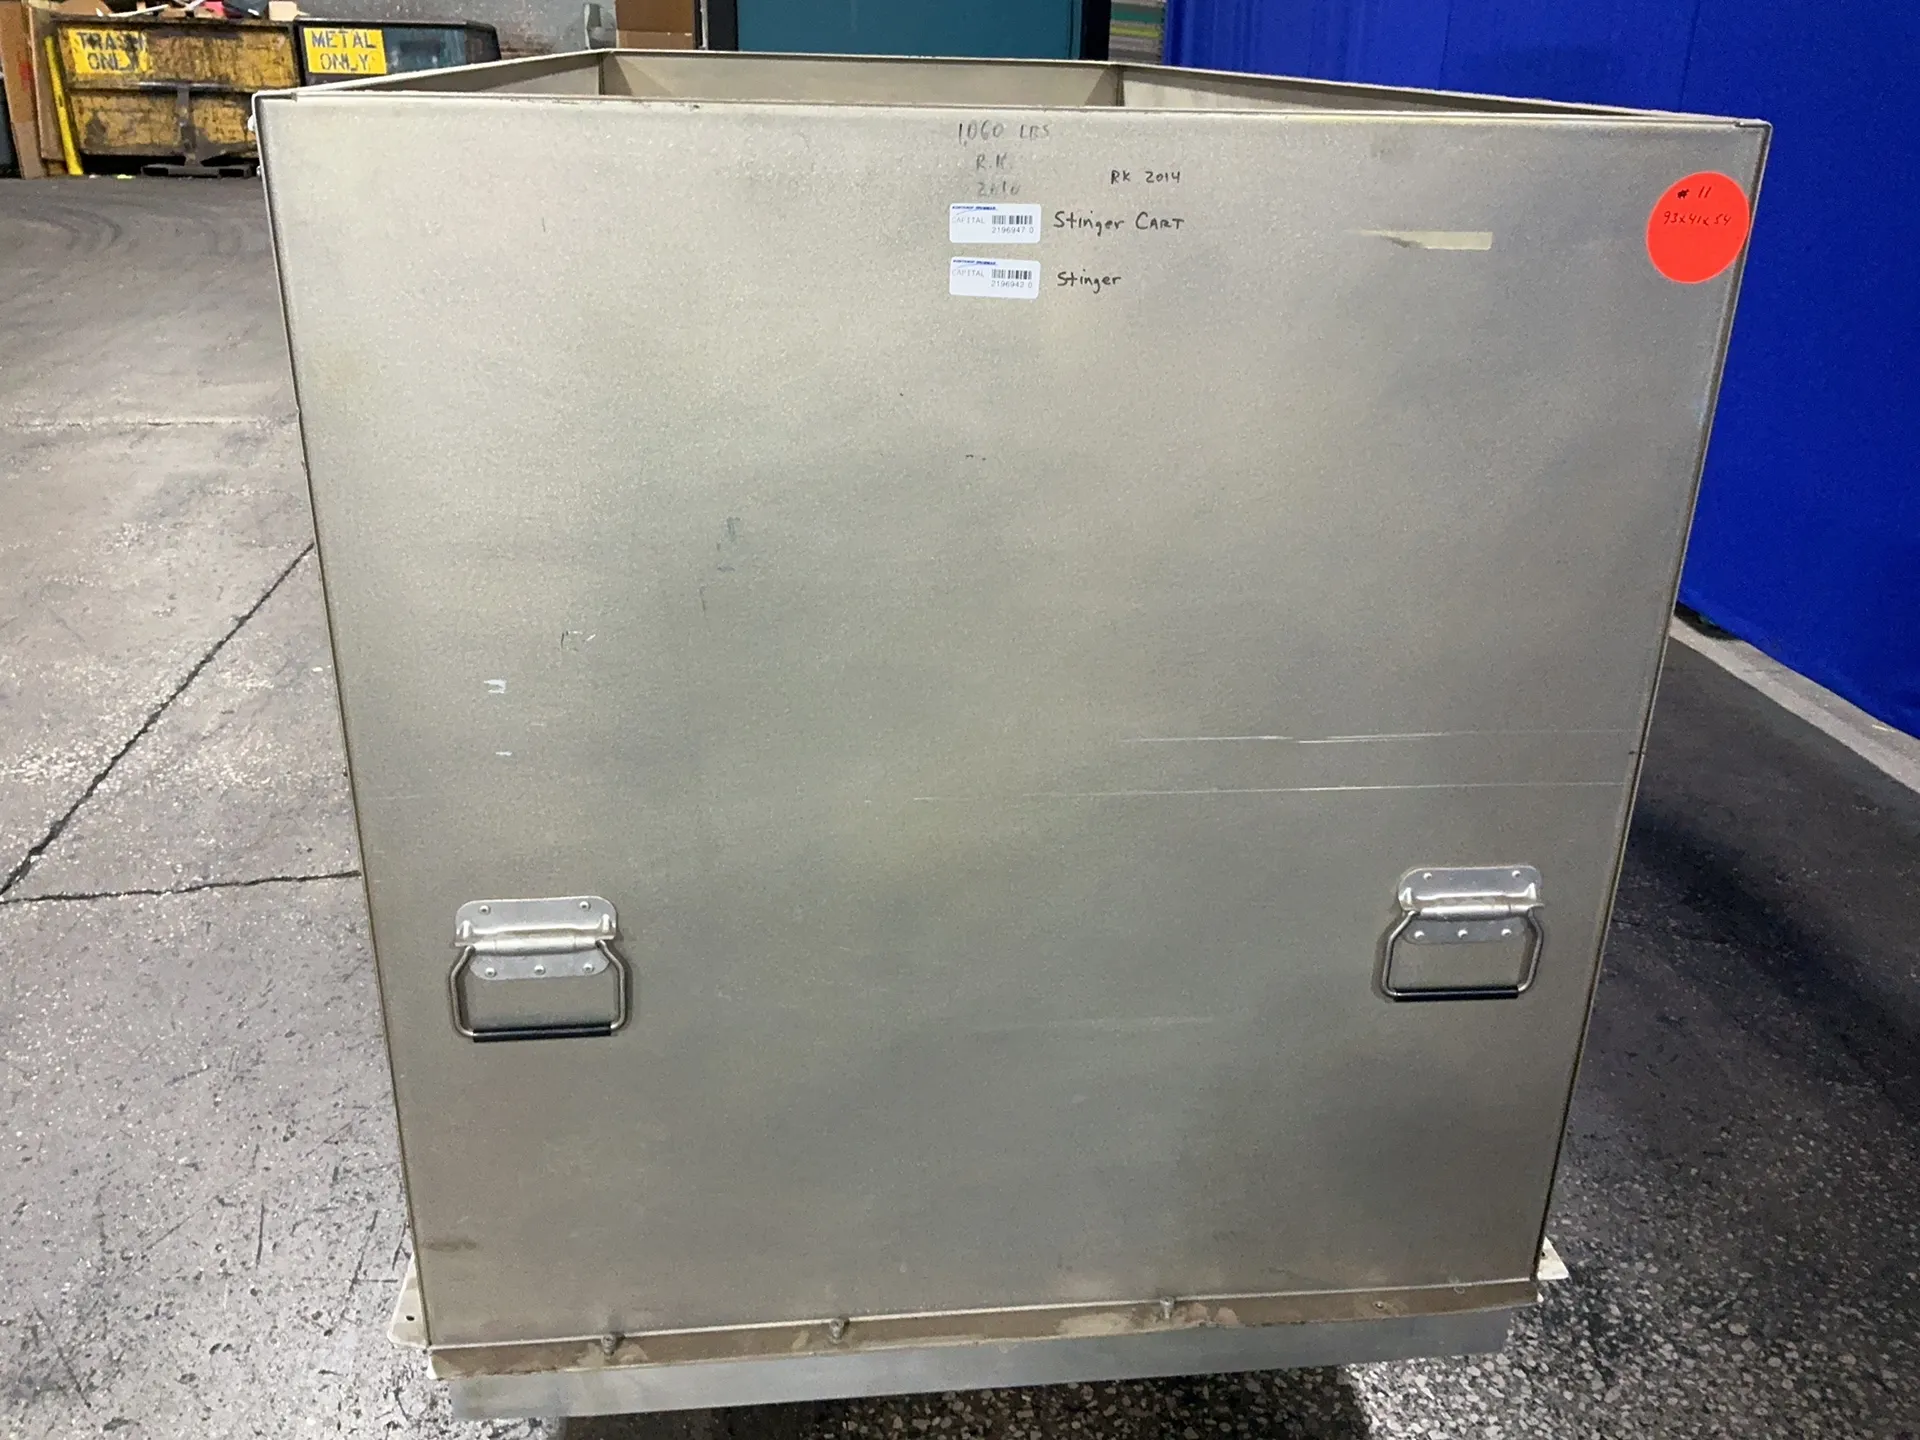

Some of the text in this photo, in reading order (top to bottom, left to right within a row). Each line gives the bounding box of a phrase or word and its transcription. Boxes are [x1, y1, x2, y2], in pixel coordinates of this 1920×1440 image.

[311, 30, 377, 48] METAL
[320, 53, 369, 71] ONLY
[1110, 169, 1181, 185] RK 2014
[1698, 186, 1712, 198] 11
[1053, 210, 1185, 237] Stinger CART
[1057, 269, 1122, 294] Stinger
